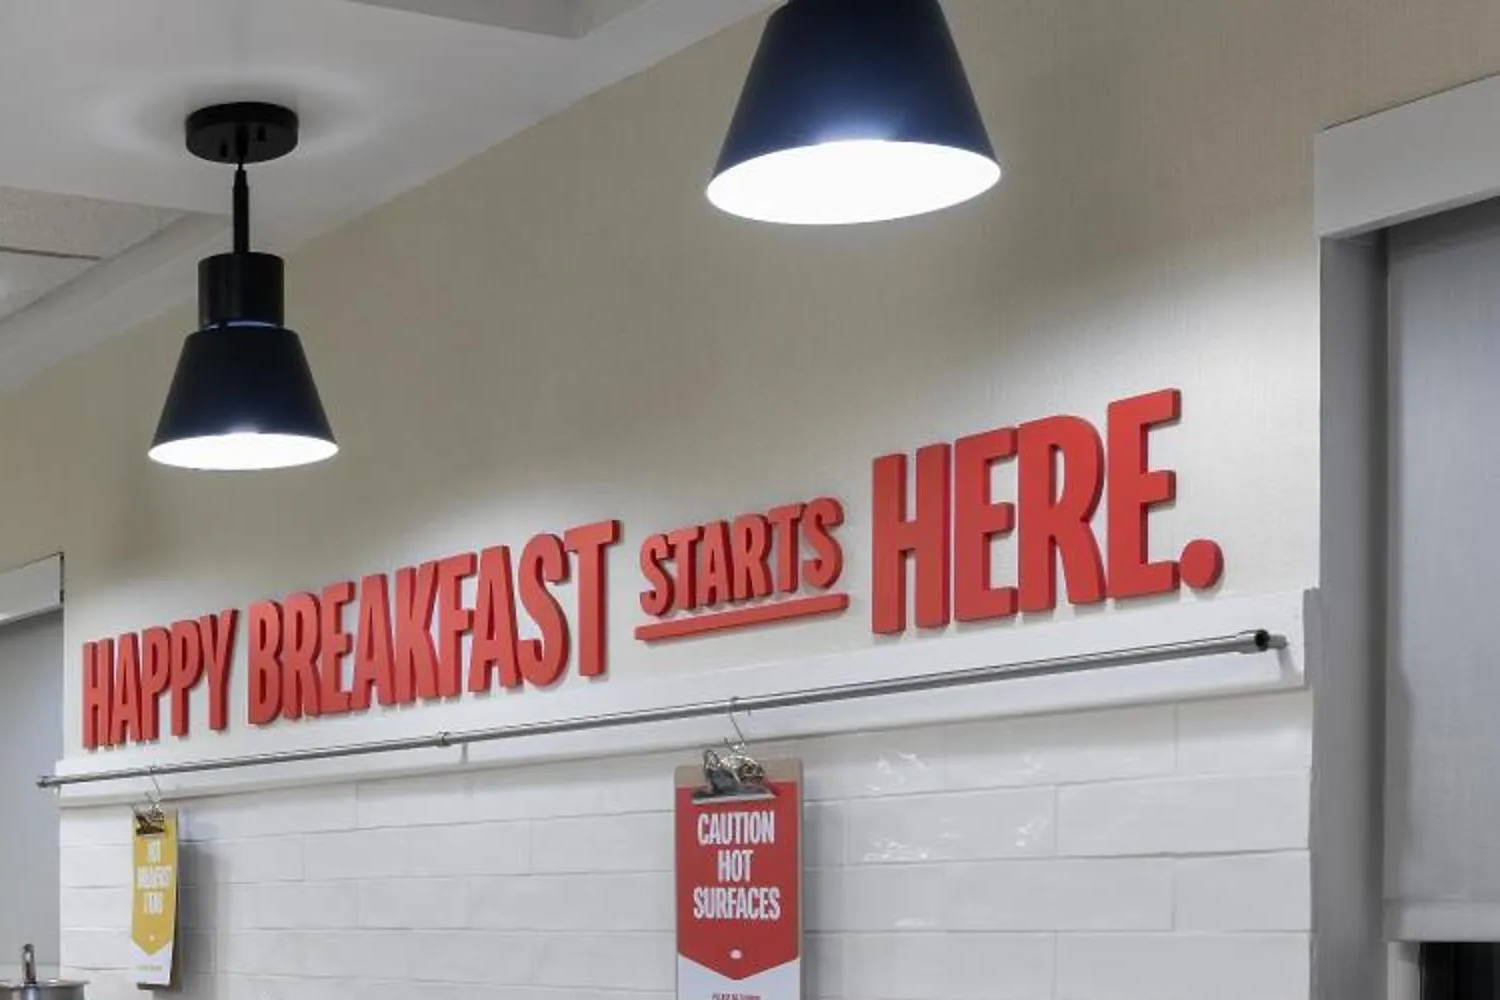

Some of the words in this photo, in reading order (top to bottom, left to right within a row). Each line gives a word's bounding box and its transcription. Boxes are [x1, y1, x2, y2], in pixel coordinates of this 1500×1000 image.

[82, 609, 240, 749] HAPPY
[247, 519, 621, 726] BREAKFAST
[639, 496, 845, 618] STARTS
[871, 388, 1225, 635] HERE.
[697, 810, 776, 846] CAUTION
[717, 849, 754, 883] HOT
[692, 886, 781, 921] SURFACES
